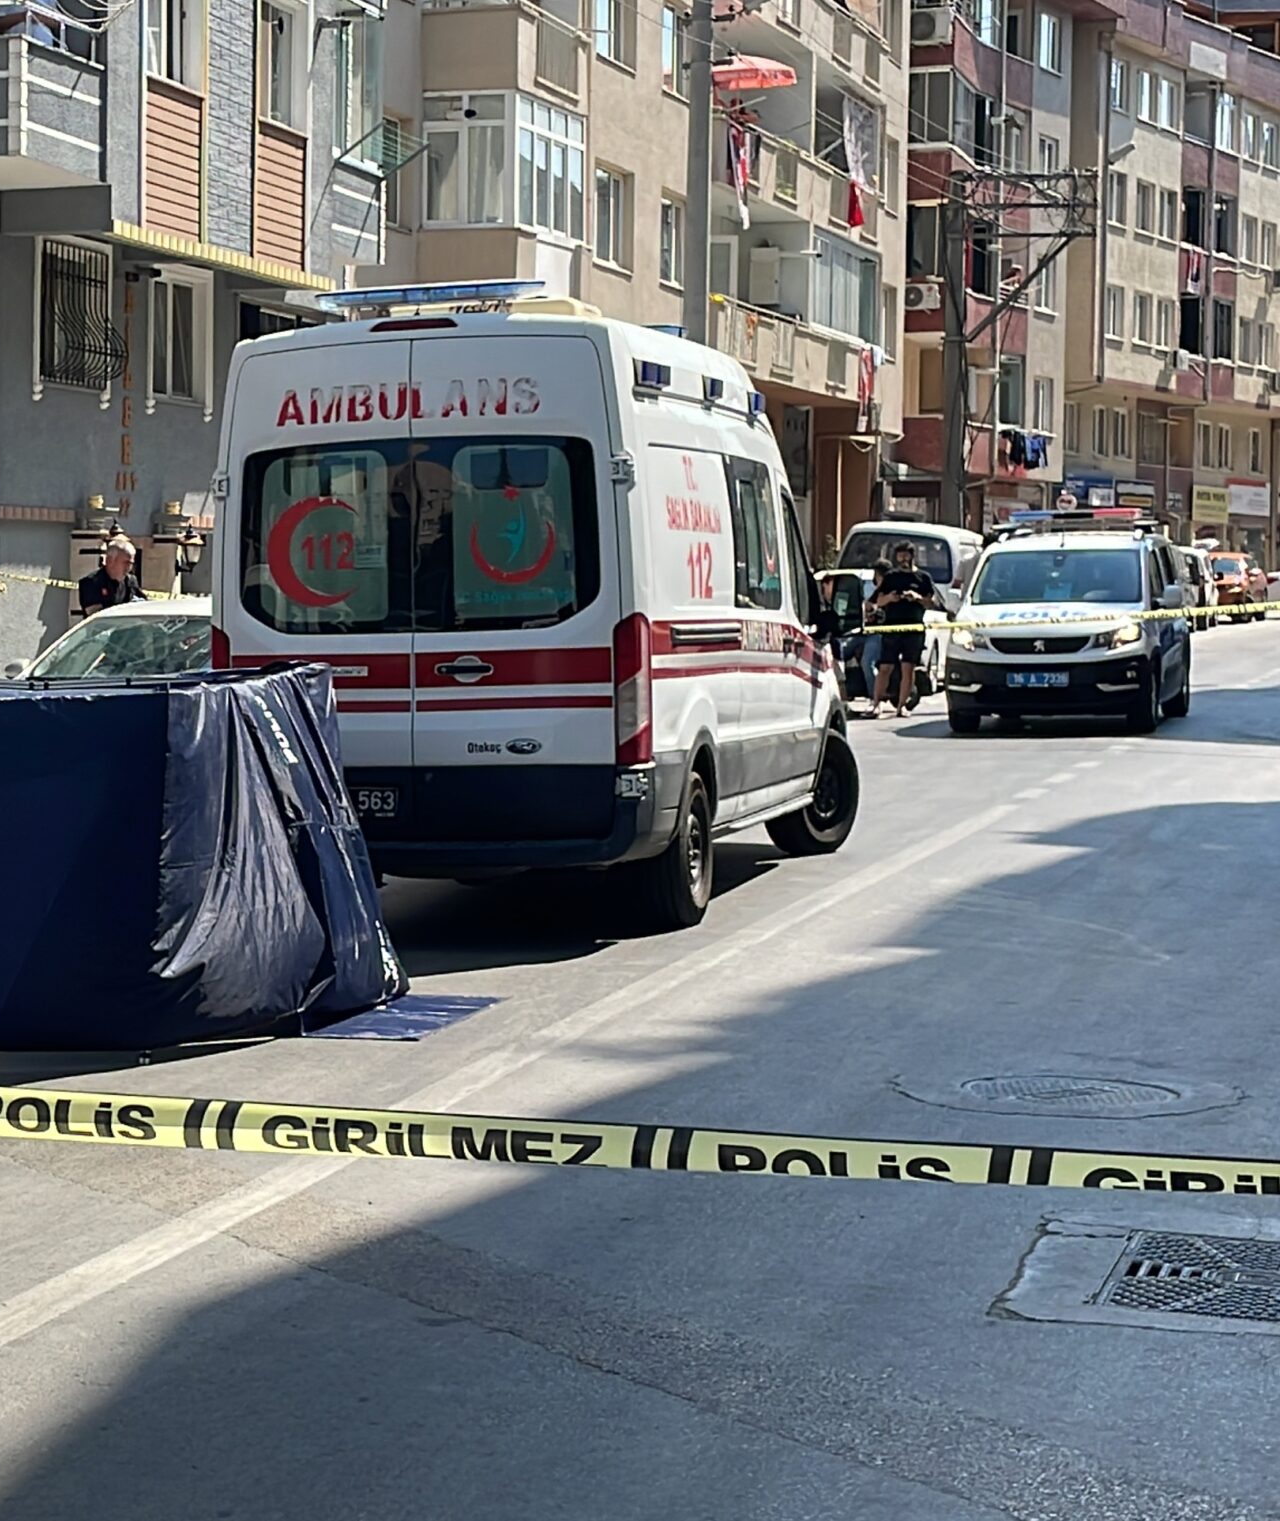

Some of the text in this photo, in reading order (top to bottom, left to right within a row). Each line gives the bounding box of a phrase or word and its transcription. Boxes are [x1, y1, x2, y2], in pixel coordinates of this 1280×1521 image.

[276, 376, 541, 427] AMBULANS
[301, 530, 355, 571] 112
[687, 542, 713, 600] 112
[358, 791, 395, 811] 563
[261, 1114, 608, 1167] GİRİLMEZ
